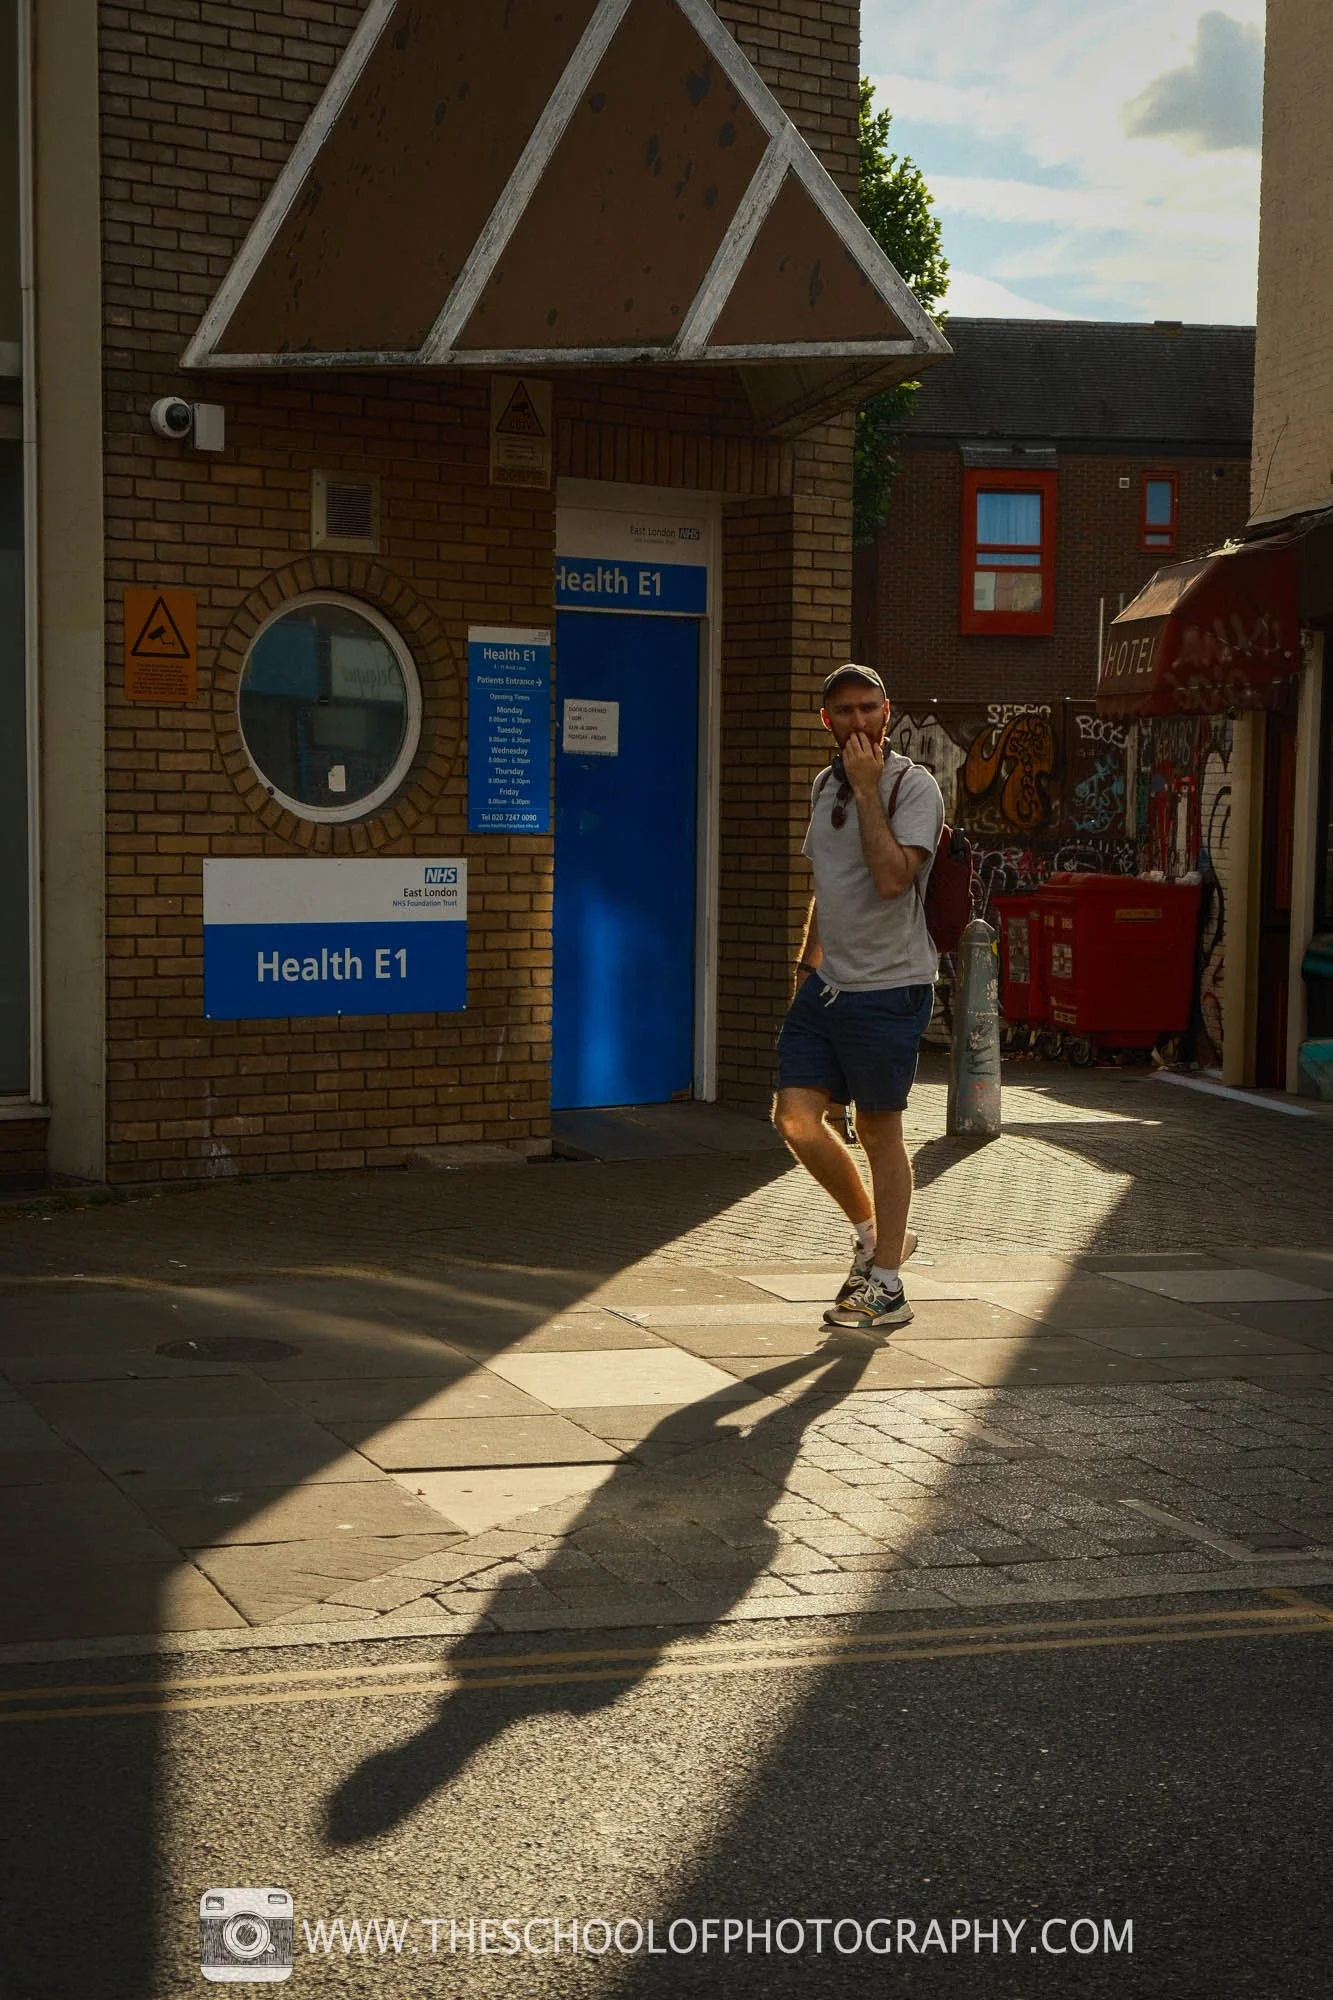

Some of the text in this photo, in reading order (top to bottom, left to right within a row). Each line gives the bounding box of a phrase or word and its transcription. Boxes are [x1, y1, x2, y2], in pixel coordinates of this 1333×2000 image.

[630, 526, 676, 537] East London
[679, 528, 700, 540] NHS
[638, 570, 662, 596] E1
[483, 648, 536, 662] Health E1
[1105, 636, 1156, 677] HOTEL
[477, 676, 535, 686] Patients Entrance
[489, 693, 514, 702] Opening
[496, 706, 523, 715] Monday
[497, 726, 523, 735] Tuesday
[491, 746, 528, 756] Wednesday
[495, 767, 524, 776] Thursday
[499, 787, 520, 797] Friday
[521, 814, 537, 822] 0090
[426, 869, 456, 883] NHS
[403, 887, 458, 897] East London
[407, 899, 441, 907] Foundation
[443, 899, 457, 907] Trust
[257, 948, 408, 982] Health E1
